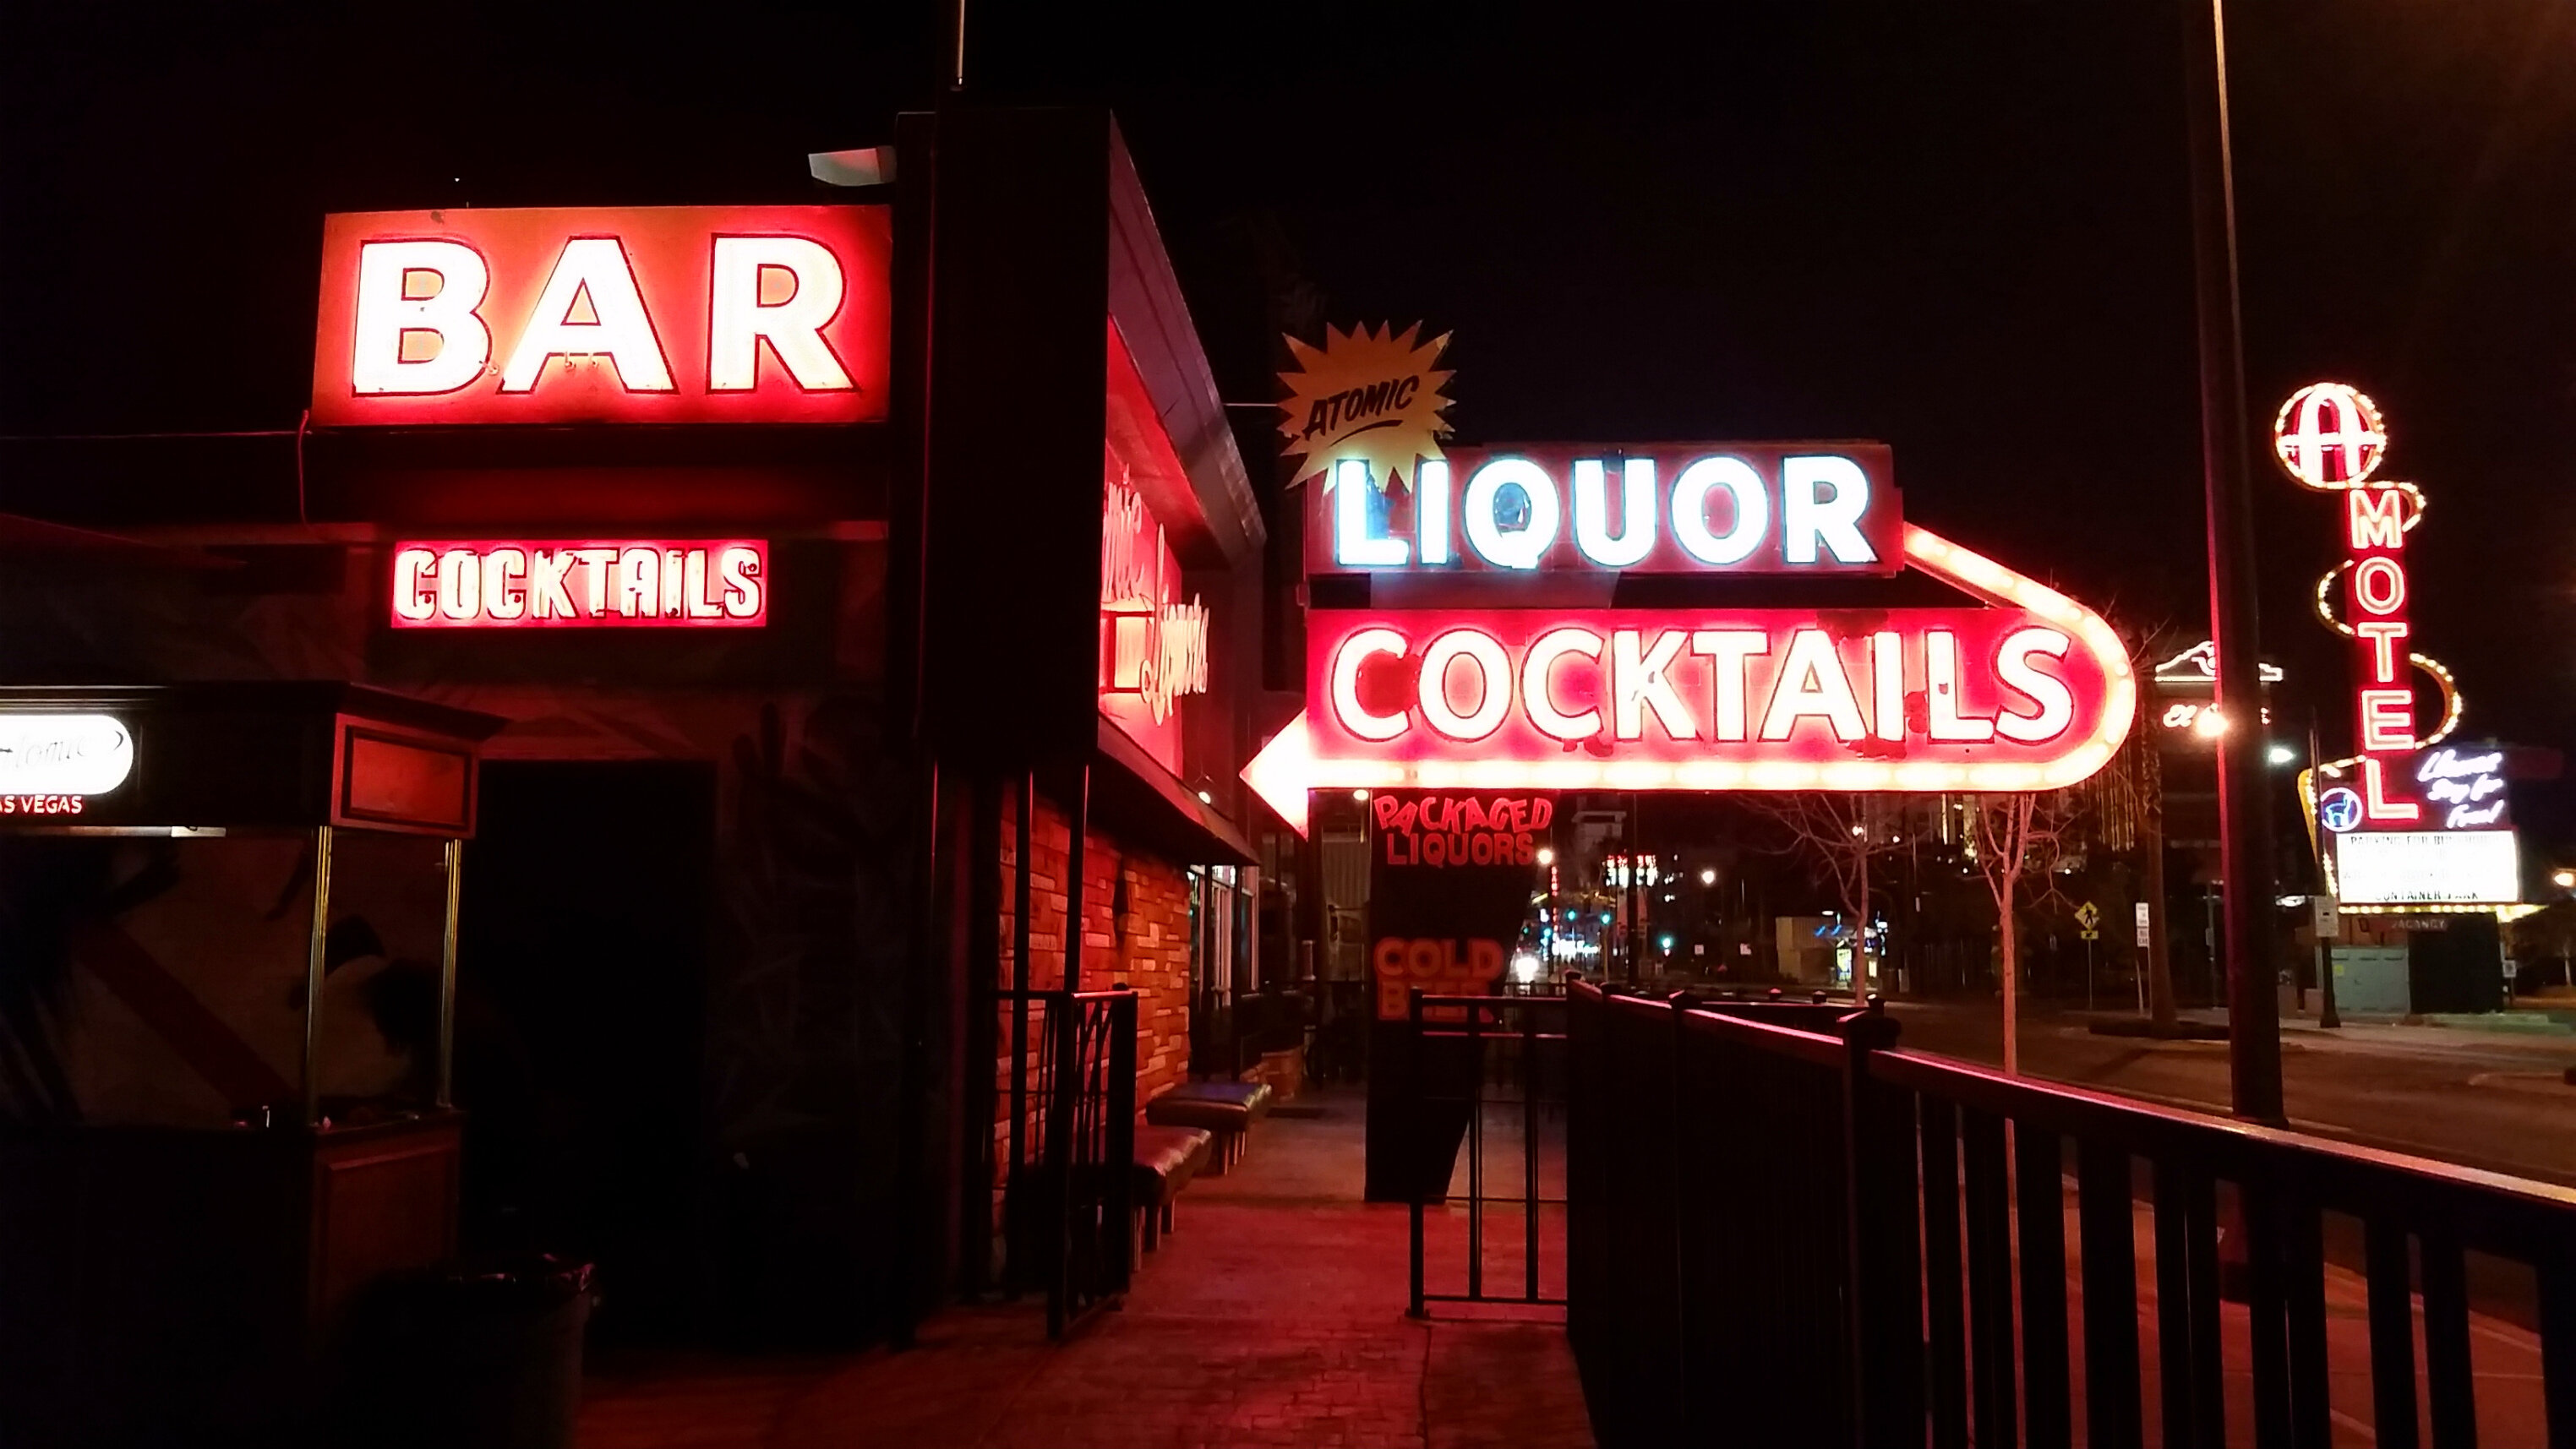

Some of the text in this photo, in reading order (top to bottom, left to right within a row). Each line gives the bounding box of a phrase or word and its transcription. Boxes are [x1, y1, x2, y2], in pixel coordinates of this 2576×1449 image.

[352, 233, 861, 395] BAR
[1302, 375, 1420, 441] ATOMIC
[1334, 455, 1881, 570] LIQUOR
[394, 547, 765, 620] COCKTAILS
[1330, 626, 2076, 744] COCKTAILS
[2349, 489, 2420, 820] MOTEL
[20, 795, 83, 814] VEGAS
[1373, 795, 1553, 836] PACKAGED
[1387, 832, 1536, 869] LIQUORS
[1373, 936, 1504, 980] COLD
